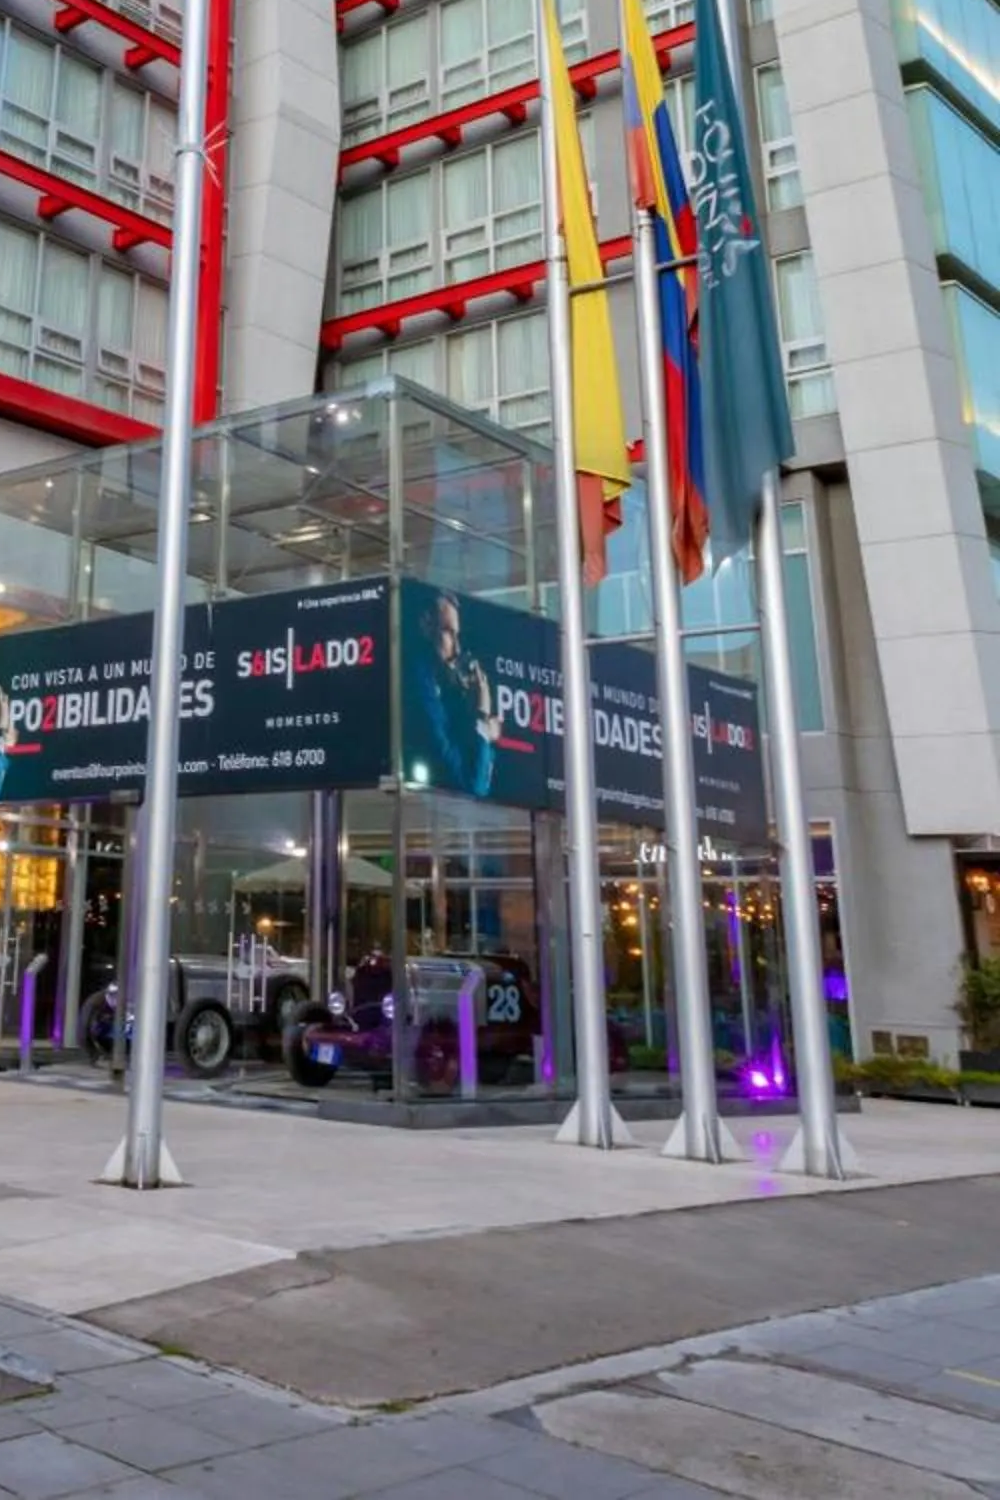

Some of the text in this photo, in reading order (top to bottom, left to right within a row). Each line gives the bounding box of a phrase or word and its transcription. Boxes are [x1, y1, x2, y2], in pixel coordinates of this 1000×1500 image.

[11, 651, 216, 691] CON VISTA A UN MUO DE
[496, 656, 524, 679] CON
[10, 679, 215, 732] PO2IBILIDAES
[603, 684, 645, 710] MUNDO
[265, 711, 341, 729] MOMENTOS
[271, 750, 293, 768] 618
[294, 748, 326, 767] 6700
[488, 985, 521, 1022] 28
